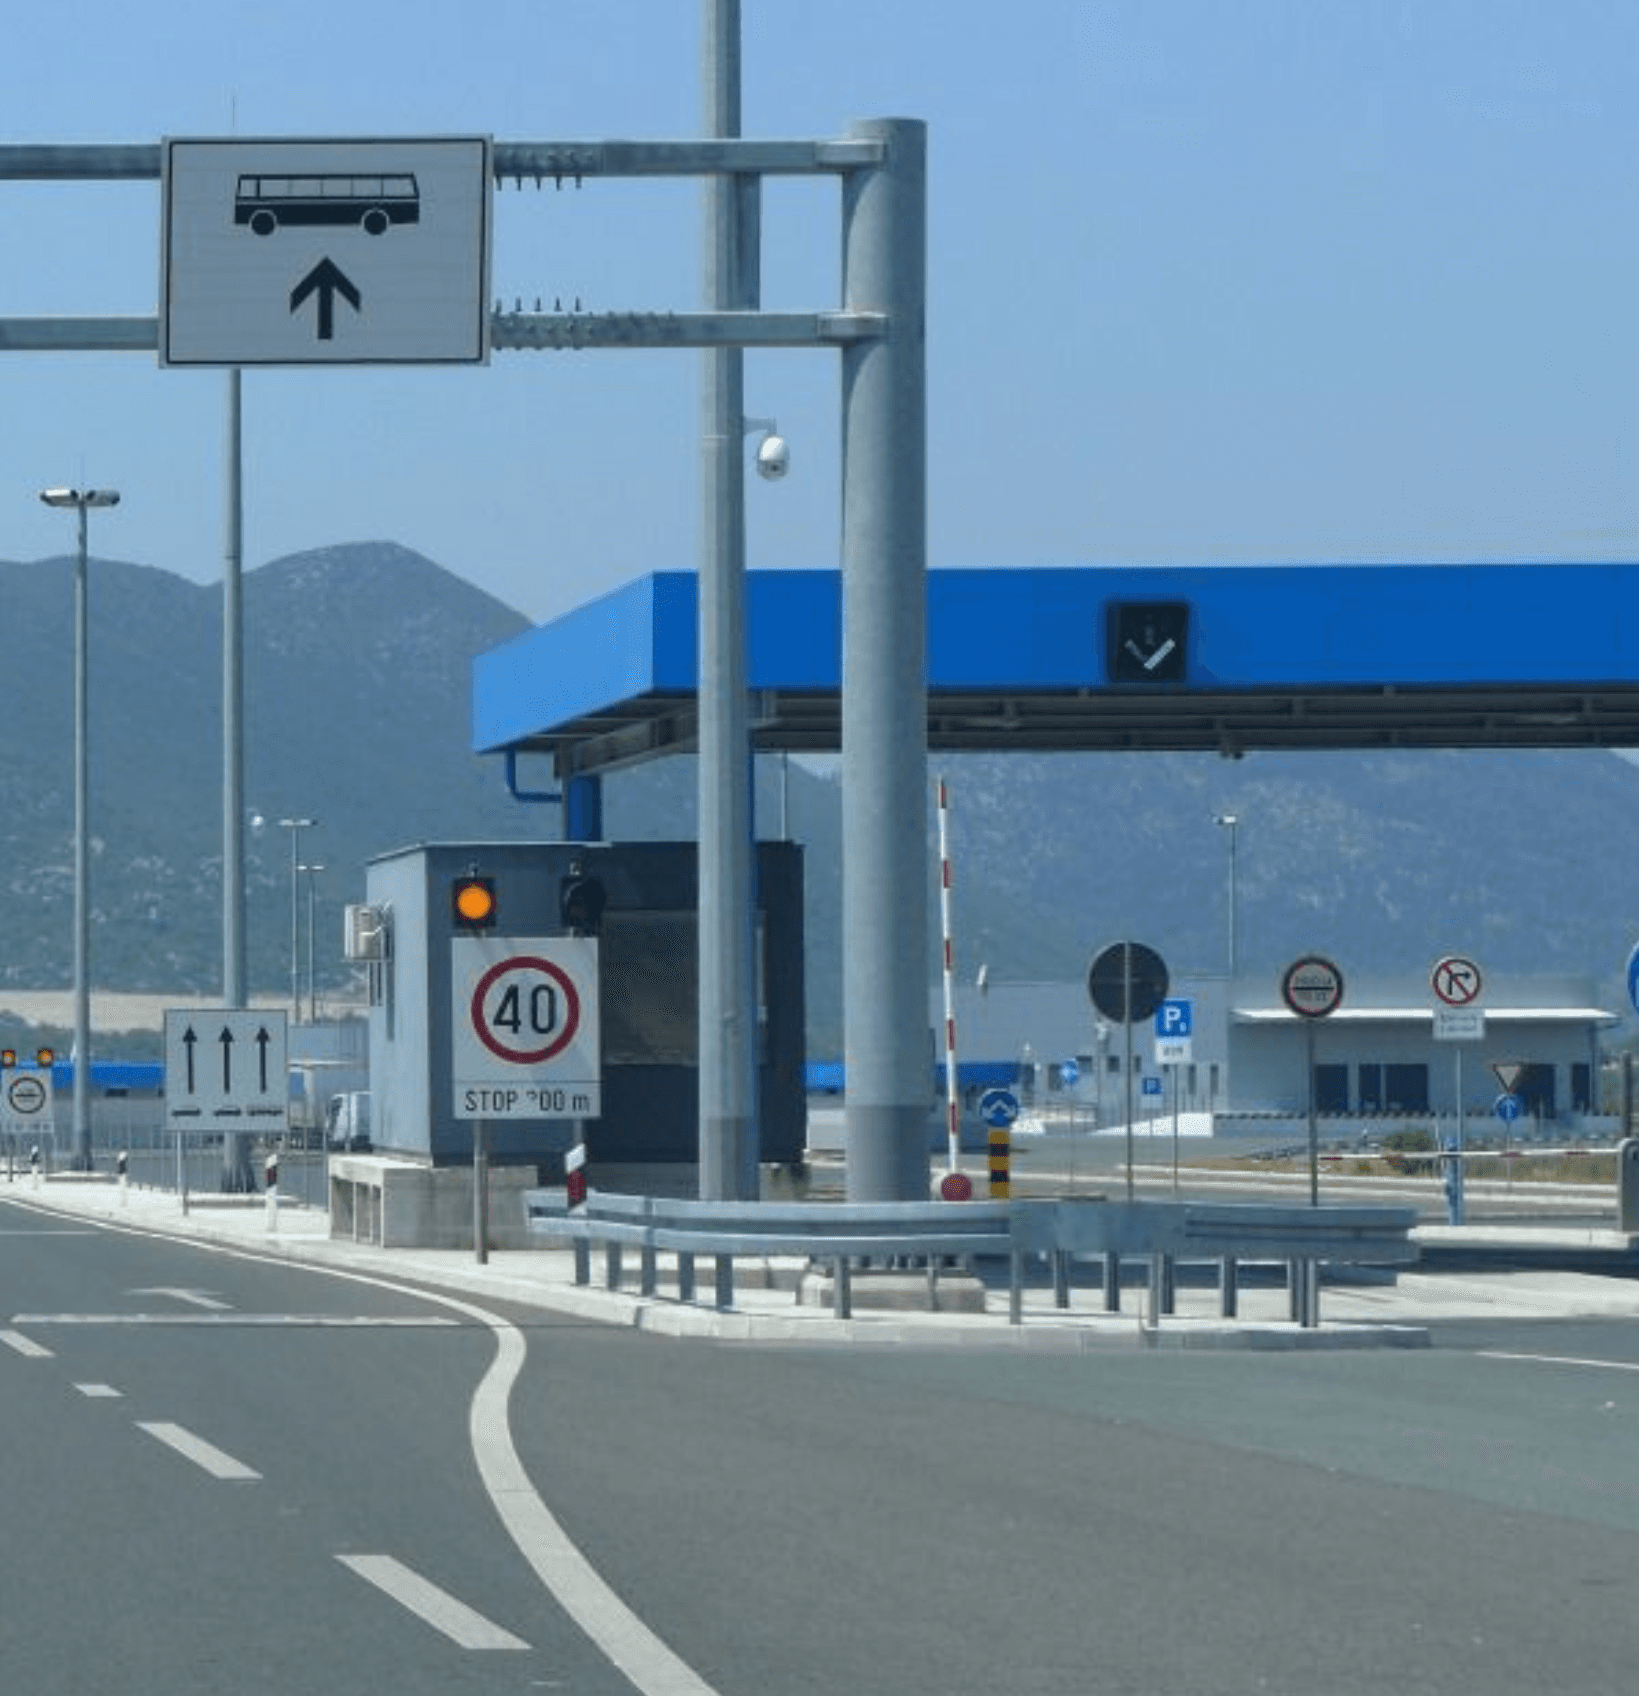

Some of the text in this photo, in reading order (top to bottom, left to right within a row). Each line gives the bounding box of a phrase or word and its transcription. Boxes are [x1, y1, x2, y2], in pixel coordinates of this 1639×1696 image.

[493, 984, 556, 1034] 40
[1165, 1006, 1181, 1031] P
[465, 1090, 518, 1111] STOP
[572, 1094, 590, 1112] m
